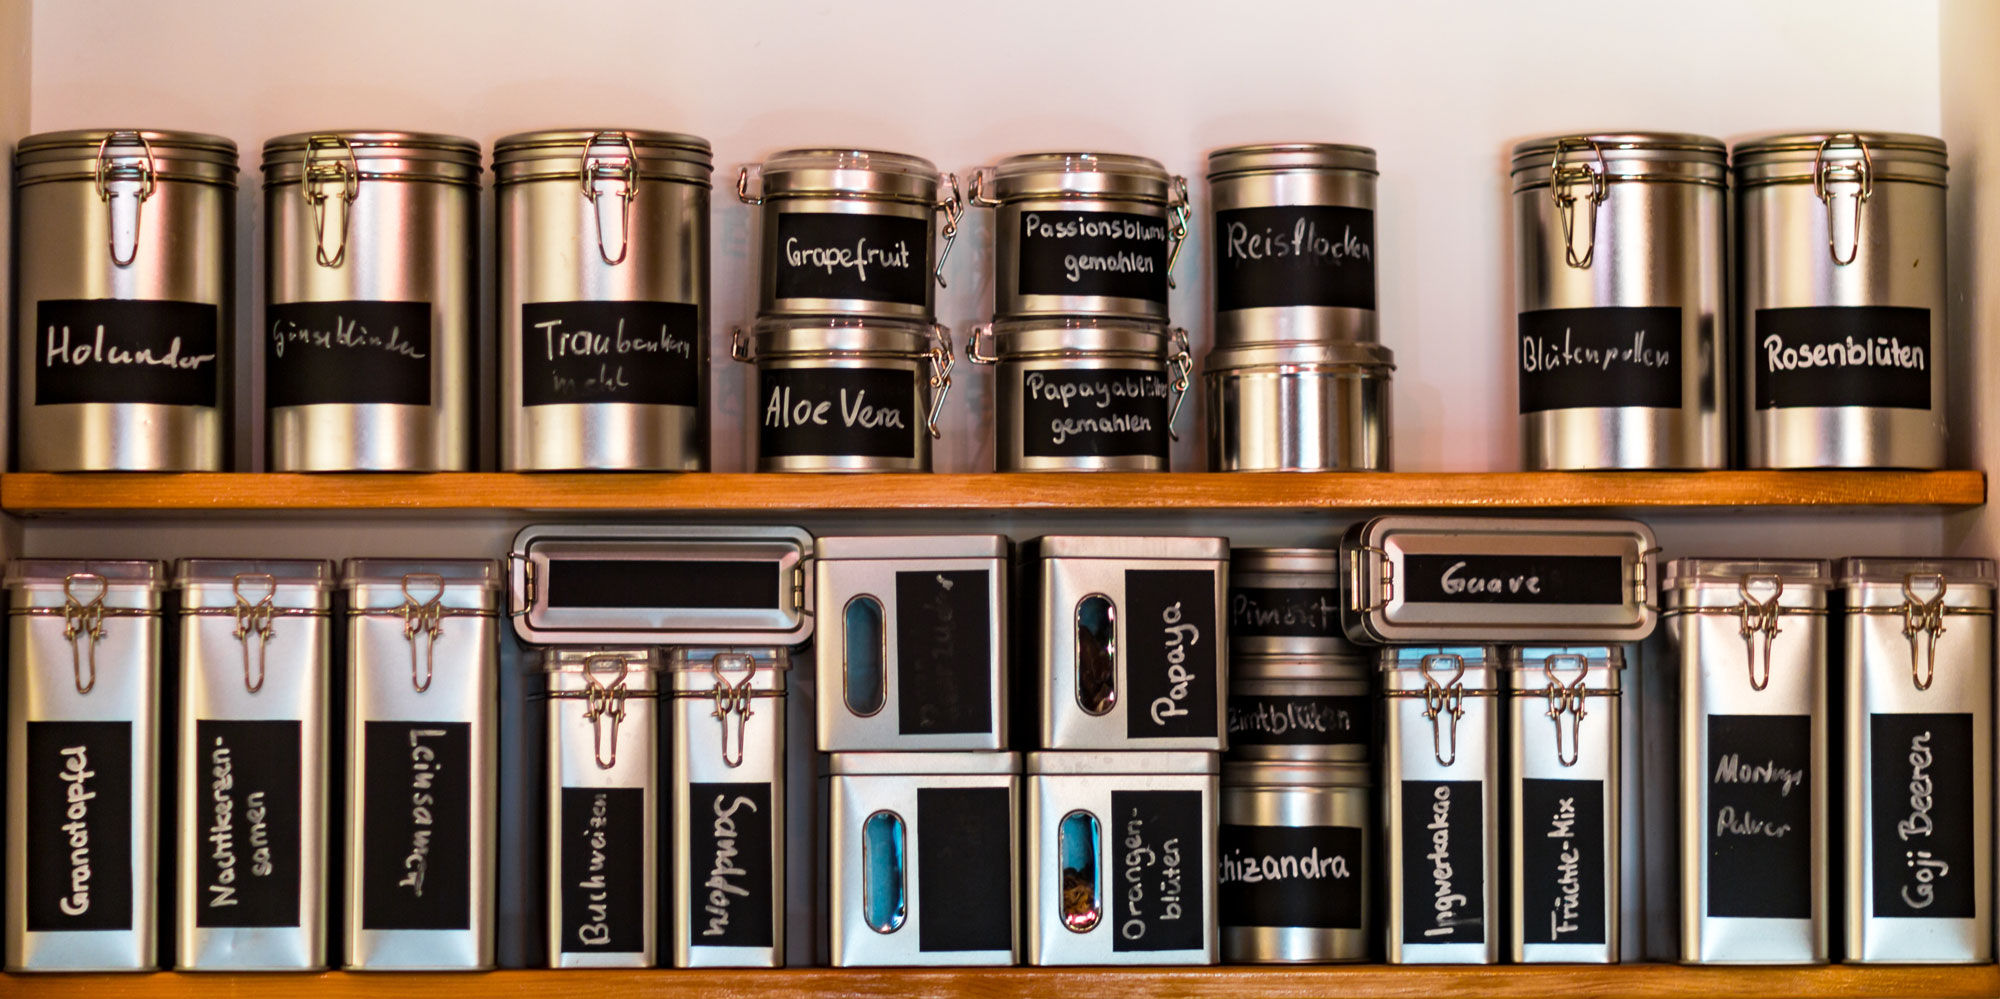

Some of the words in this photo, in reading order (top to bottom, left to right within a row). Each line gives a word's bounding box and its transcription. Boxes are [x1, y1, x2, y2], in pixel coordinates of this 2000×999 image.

[785, 236, 910, 282] Grapefruit
[1064, 250, 1154, 283] gemahlen
[1226, 217, 1372, 262] Reisflocken
[45, 324, 217, 370] Holunder
[1520, 327, 1671, 374] Blütenpollen
[1763, 333, 1926, 373] Rosenblüten
[764, 384, 832, 429] Aloe
[839, 387, 905, 429] Vera
[1050, 413, 1153, 445] gemahlen
[1440, 560, 1542, 596] Guave
[1149, 600, 1200, 727] Papaya
[207, 735, 240, 908] Nachtkerzen-
[1896, 729, 1934, 842] Beeren
[58, 744, 97, 917] Granatapfel
[246, 790, 273, 878] samen
[577, 792, 612, 947] Buchweizen
[702, 793, 759, 938] Sanddorn
[1423, 784, 1468, 938] Ingwerkakao
[1546, 795, 1580, 942] Früchte-Mix
[1120, 806, 1157, 942] Orangen-
[1159, 836, 1182, 921] blüten
[1901, 850, 1950, 910] Goji
